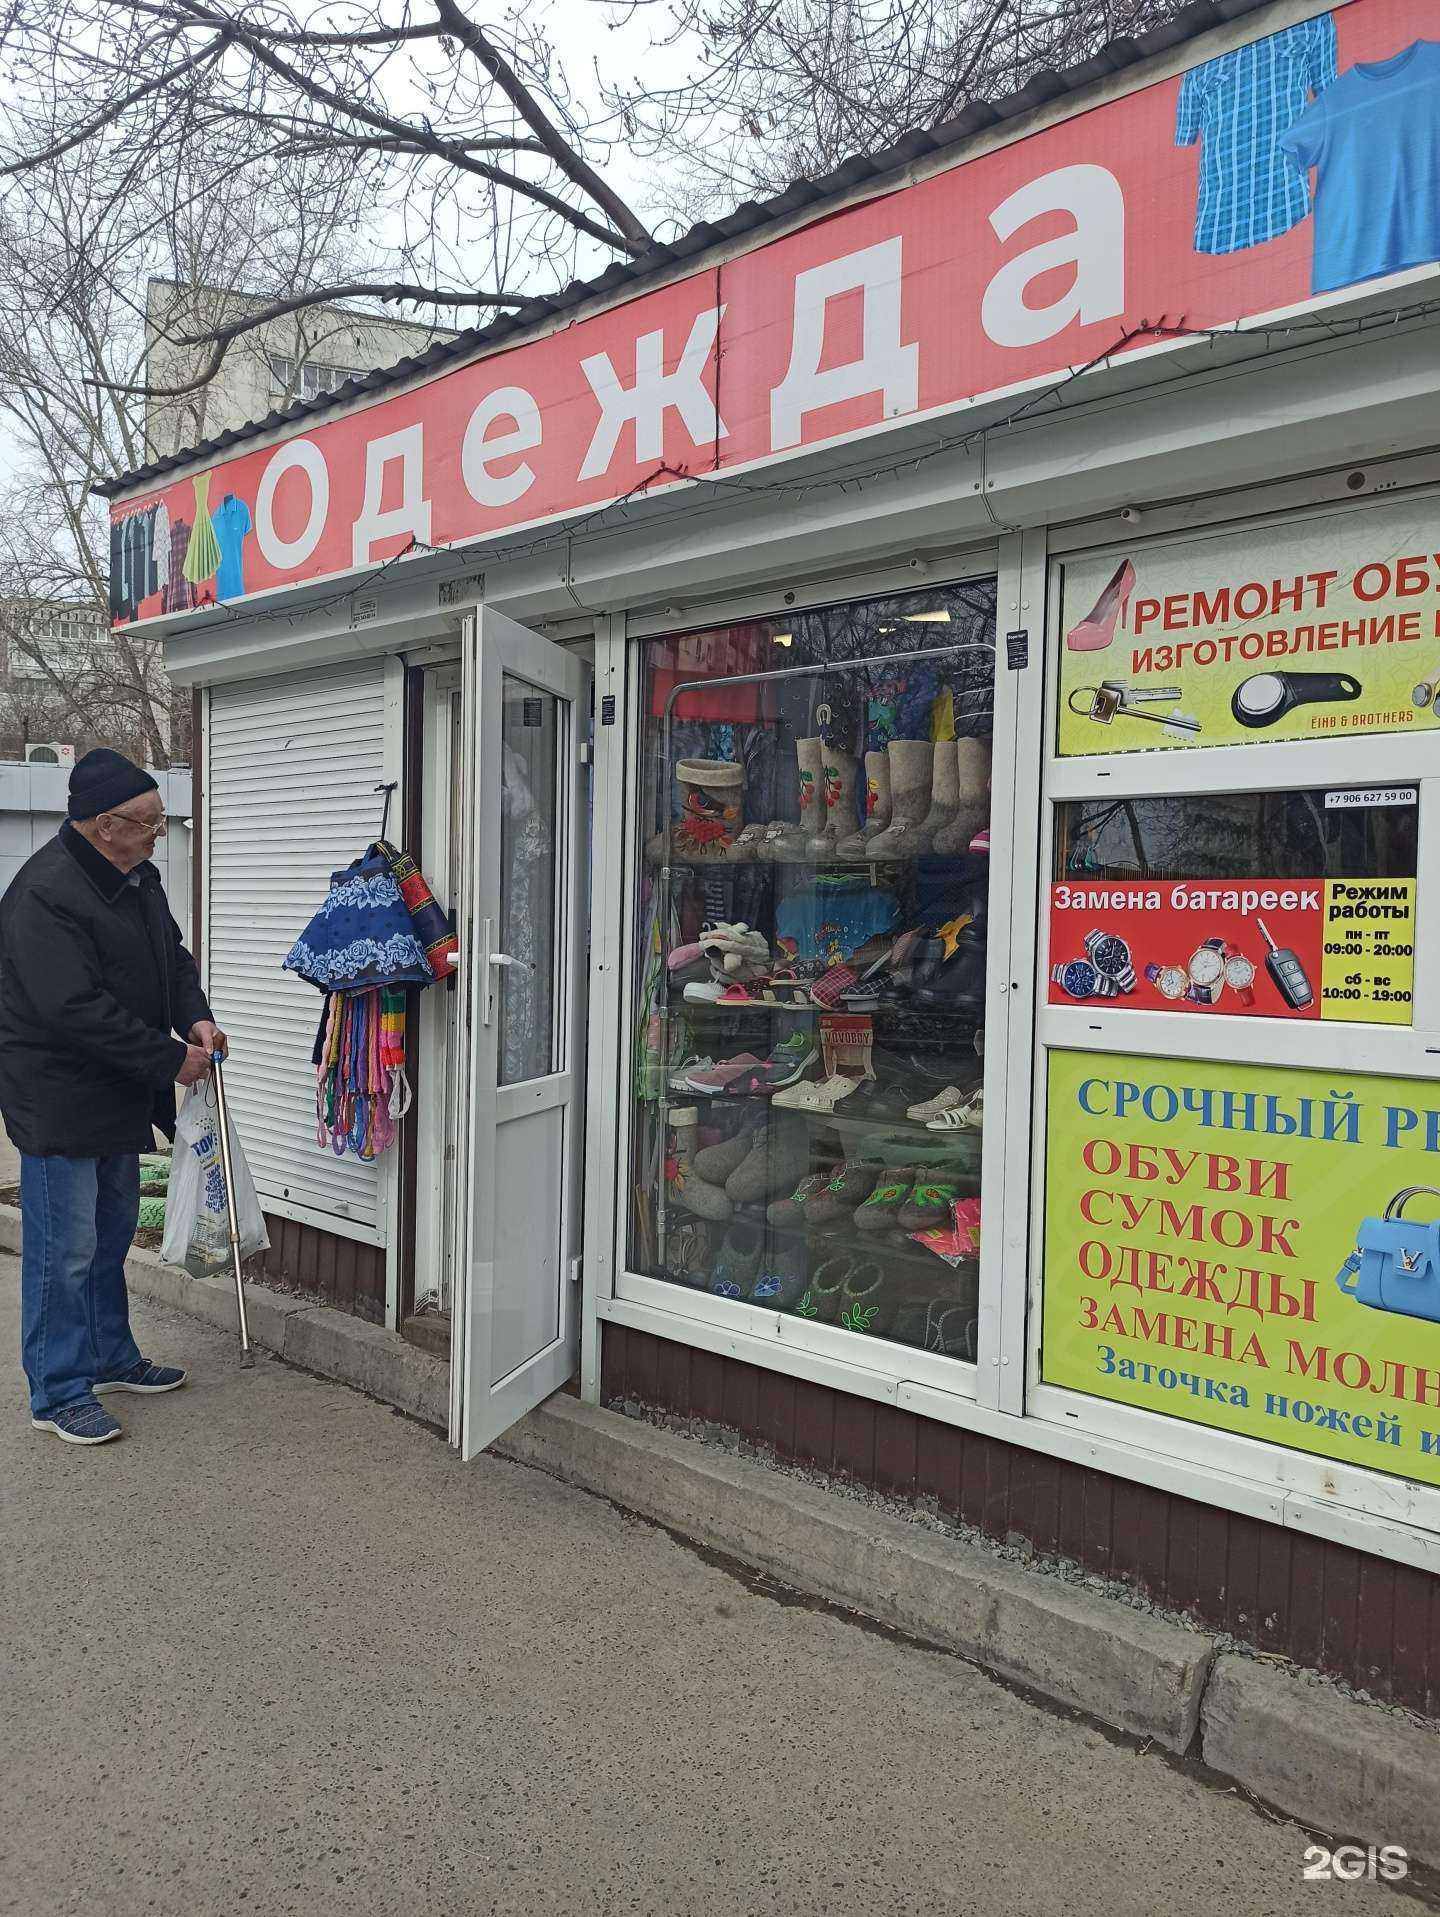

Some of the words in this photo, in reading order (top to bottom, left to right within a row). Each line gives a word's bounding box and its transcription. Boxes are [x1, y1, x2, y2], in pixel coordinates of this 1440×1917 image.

[1134, 570, 1338, 635] РЕМОНТ
[1352, 553, 1440, 602] ОБ
[1131, 611, 1422, 674] ИЗГОТОВЛЕНИЕ
[1352, 710, 1414, 726] BROTHERS
[1329, 795, 1341, 803] +7
[1343, 794, 1361, 803] 906
[1363, 793, 1382, 802] 627
[1384, 792, 1397, 801] 59
[1399, 791, 1412, 800] 00
[1054, 886, 1161, 910] Замена
[1170, 884, 1320, 915] батареек
[1332, 883, 1408, 900] Режим
[1328, 902, 1409, 921] работы
[1324, 943, 1362, 954] 09:00
[1373, 944, 1412, 956] 20:00
[1345, 930, 1362, 940] пн
[1374, 931, 1390, 940] пт
[1322, 987, 1361, 999] 10:00
[1372, 990, 1411, 1002] 19:00
[1344, 972, 1362, 985] сб
[1373, 976, 1391, 986] вс
[1077, 1078, 1364, 1144] СРОЧНЫЙ
[1082, 1139, 1294, 1201] ОБУВИ
[1080, 1189, 1301, 1258] СУМОК
[1078, 1240, 1320, 1323] ОДЕЖДЫ
[1078, 1296, 1271, 1370] ЗАМЕНА
[1096, 1344, 1250, 1409] Заточка
[1264, 1391, 1402, 1447] ножей
